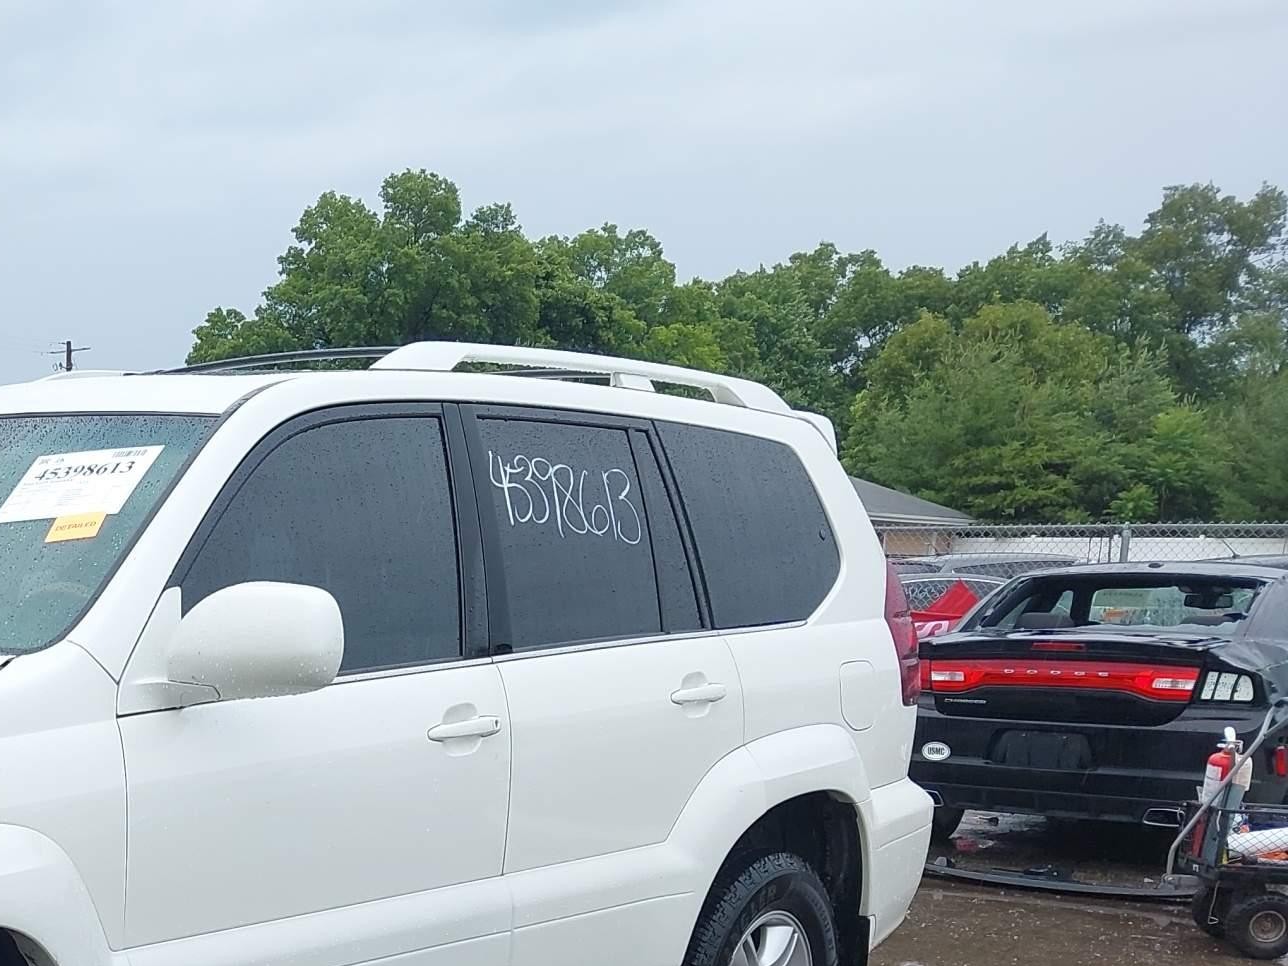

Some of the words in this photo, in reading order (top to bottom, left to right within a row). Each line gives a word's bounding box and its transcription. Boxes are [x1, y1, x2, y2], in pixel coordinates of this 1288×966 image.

[34, 460, 136, 481] 45398613
[489, 450, 641, 545] 45398613
[1004, 668, 1109, 677] DODGE
[927, 746, 945, 757] USMC
